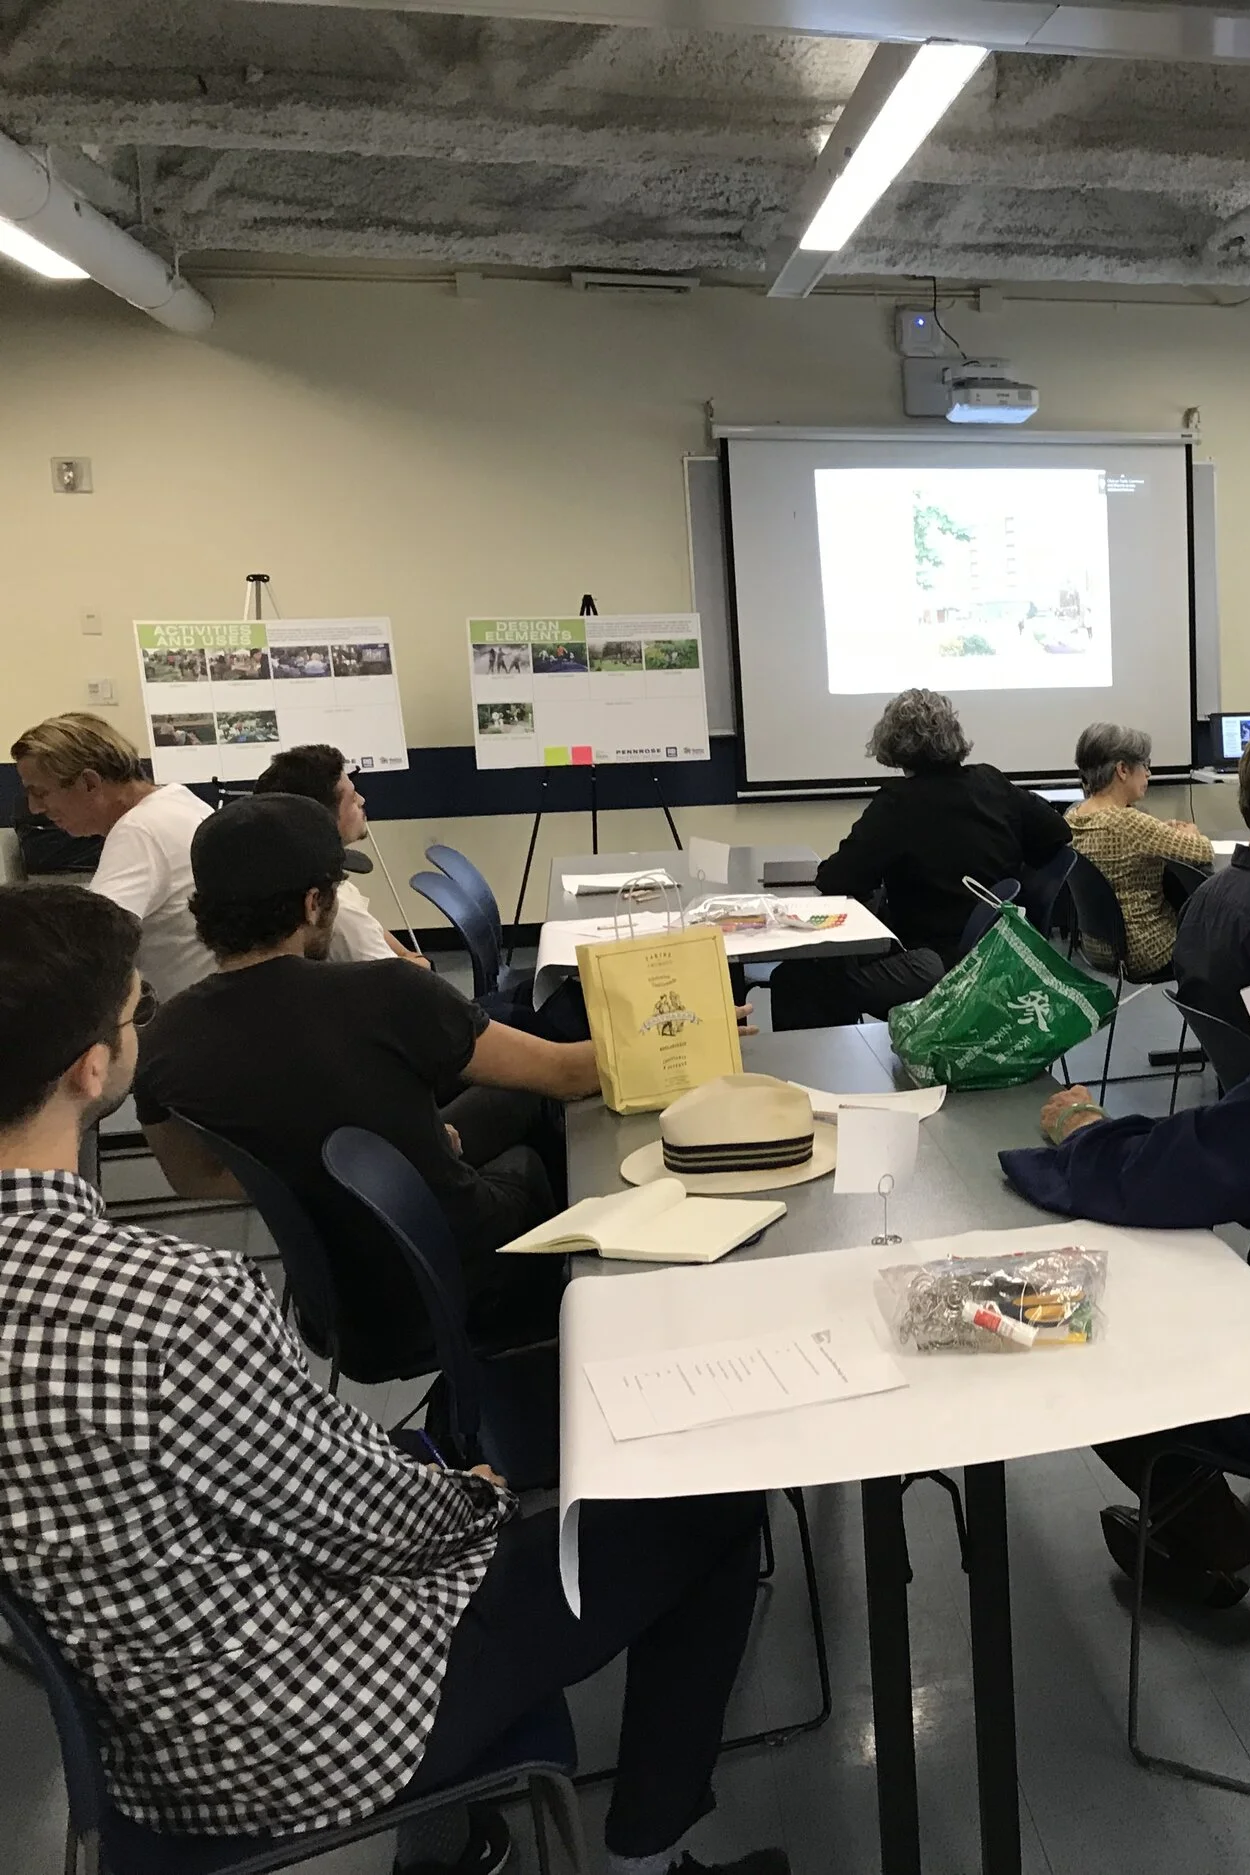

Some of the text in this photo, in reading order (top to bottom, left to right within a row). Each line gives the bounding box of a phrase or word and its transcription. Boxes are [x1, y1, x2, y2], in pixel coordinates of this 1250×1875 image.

[153, 624, 251, 636] ACTIVITIES
[496, 620, 560, 632] DESIGN
[157, 634, 251, 647] AND USES
[485, 630, 572, 642] ELEMENTS
[615, 747, 662, 755] PENNROSE
